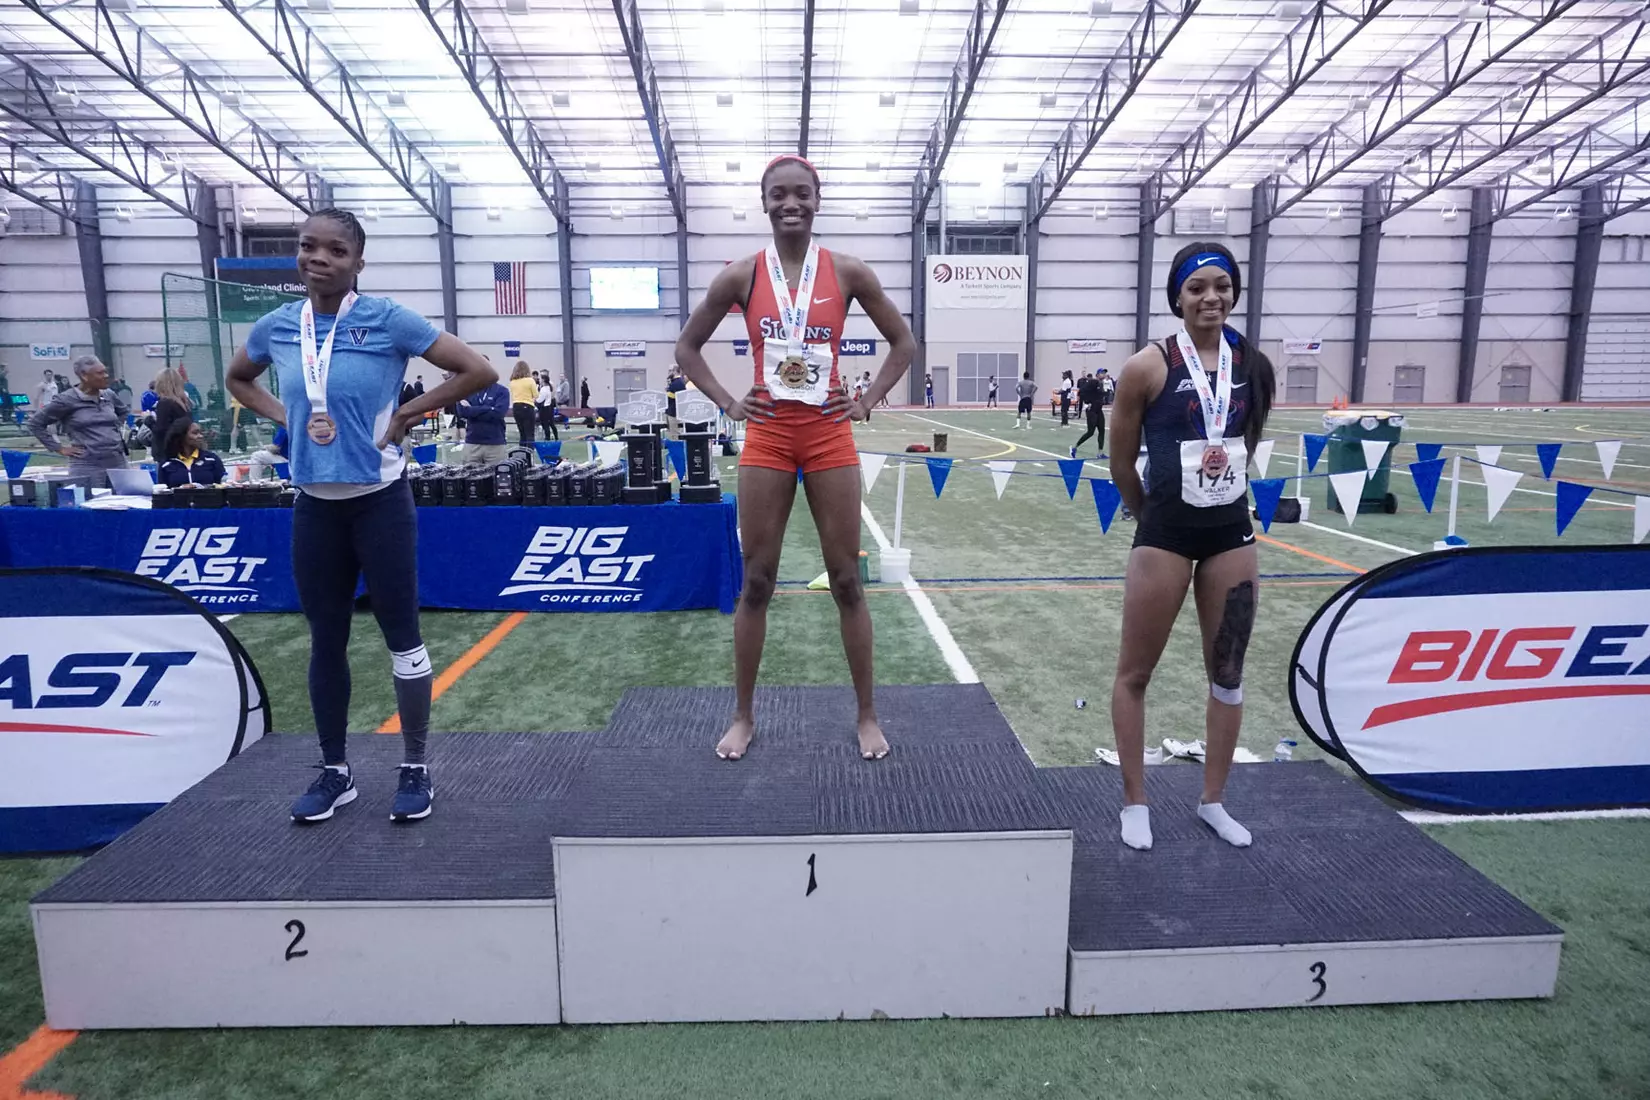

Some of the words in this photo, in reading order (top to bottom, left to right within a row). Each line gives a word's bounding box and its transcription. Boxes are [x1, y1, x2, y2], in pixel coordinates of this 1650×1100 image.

[954, 265, 1024, 280] BEYNON
[283, 283, 307, 292] Clinic
[841, 341, 870, 353] Jeep
[141, 527, 239, 557] BIG
[525, 526, 629, 555] BIG
[134, 557, 267, 584] EAST
[510, 554, 655, 583] EAST
[540, 593, 643, 603] CONFERENCE
[1387, 626, 1576, 684] BIG
[1564, 624, 1650, 677] E
[806, 853, 818, 897] 1
[284, 920, 309, 961] 2
[1306, 961, 1327, 1002] 3
